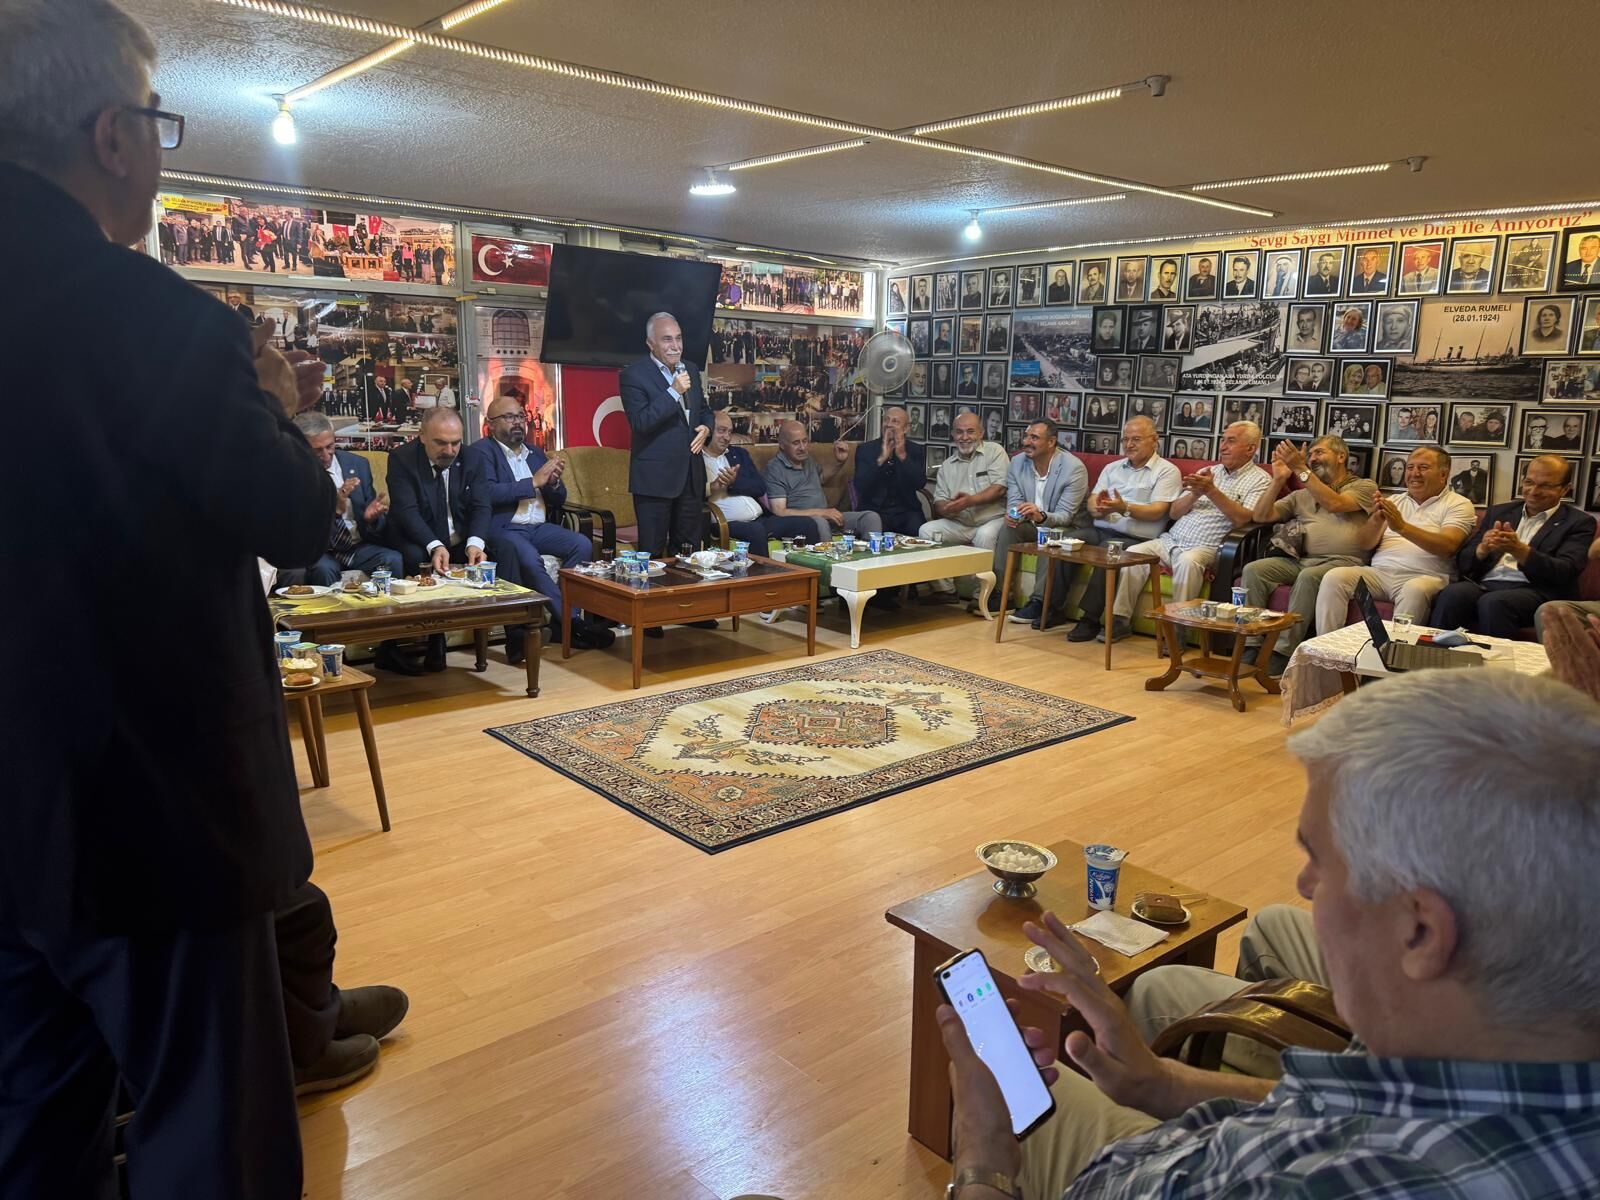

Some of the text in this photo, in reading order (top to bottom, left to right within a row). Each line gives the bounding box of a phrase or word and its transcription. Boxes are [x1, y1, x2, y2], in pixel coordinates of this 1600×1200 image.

[1291, 231, 1331, 246] Saygı
[1336, 227, 1394, 243] Minnet
[1400, 227, 1418, 238] ve
[1423, 223, 1456, 236] Dua
[1478, 303, 1512, 312] RUMELİ
[1452, 314, 1500, 323] (28.01.1924)
